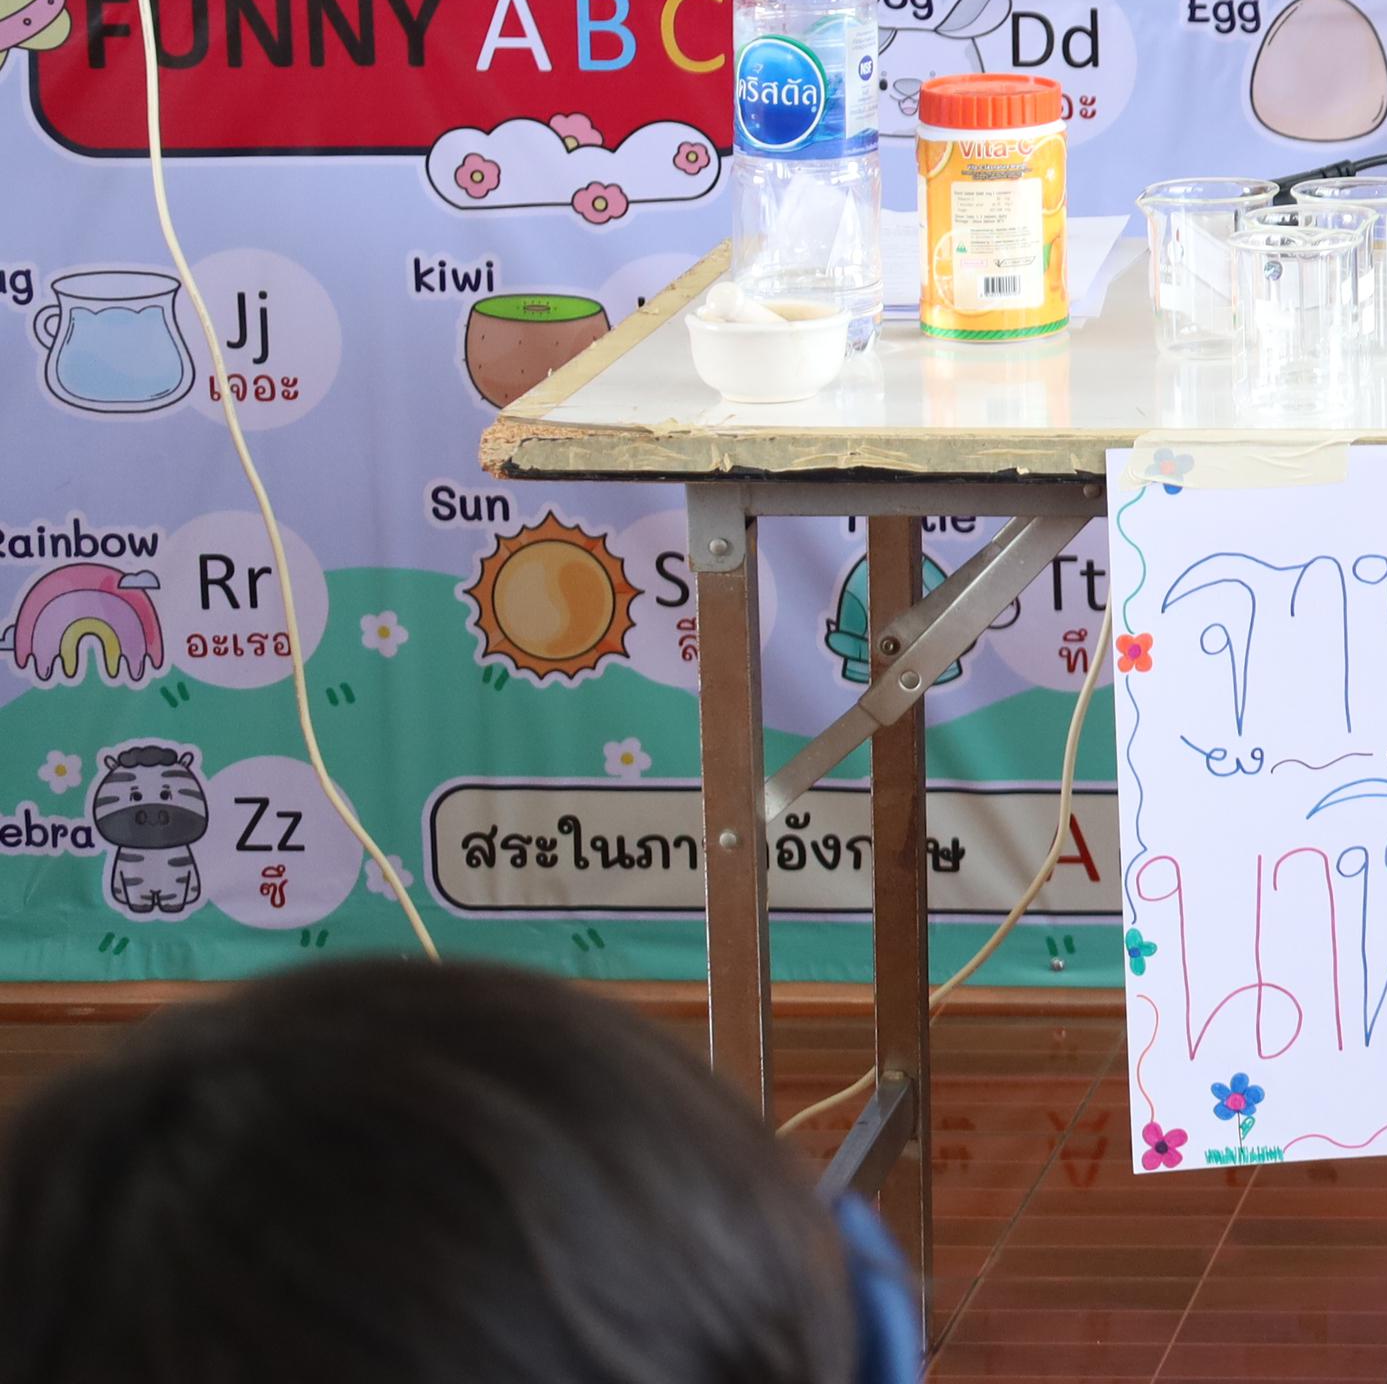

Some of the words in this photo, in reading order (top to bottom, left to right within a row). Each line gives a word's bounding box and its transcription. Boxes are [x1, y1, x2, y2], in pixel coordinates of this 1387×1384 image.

[1011, 7, 1099, 68] Dd
[737, 76, 818, 106] คริสตัล
[959, 139, 1033, 159] Vita-C
[413, 257, 495, 293] kiwi
[226, 290, 270, 365] Jj
[430, 485, 510, 523] Sun
[199, 553, 272, 610] Rr
[655, 550, 691, 608] S
[0, 808, 96, 849] ebra
[233, 796, 306, 852] Zz
